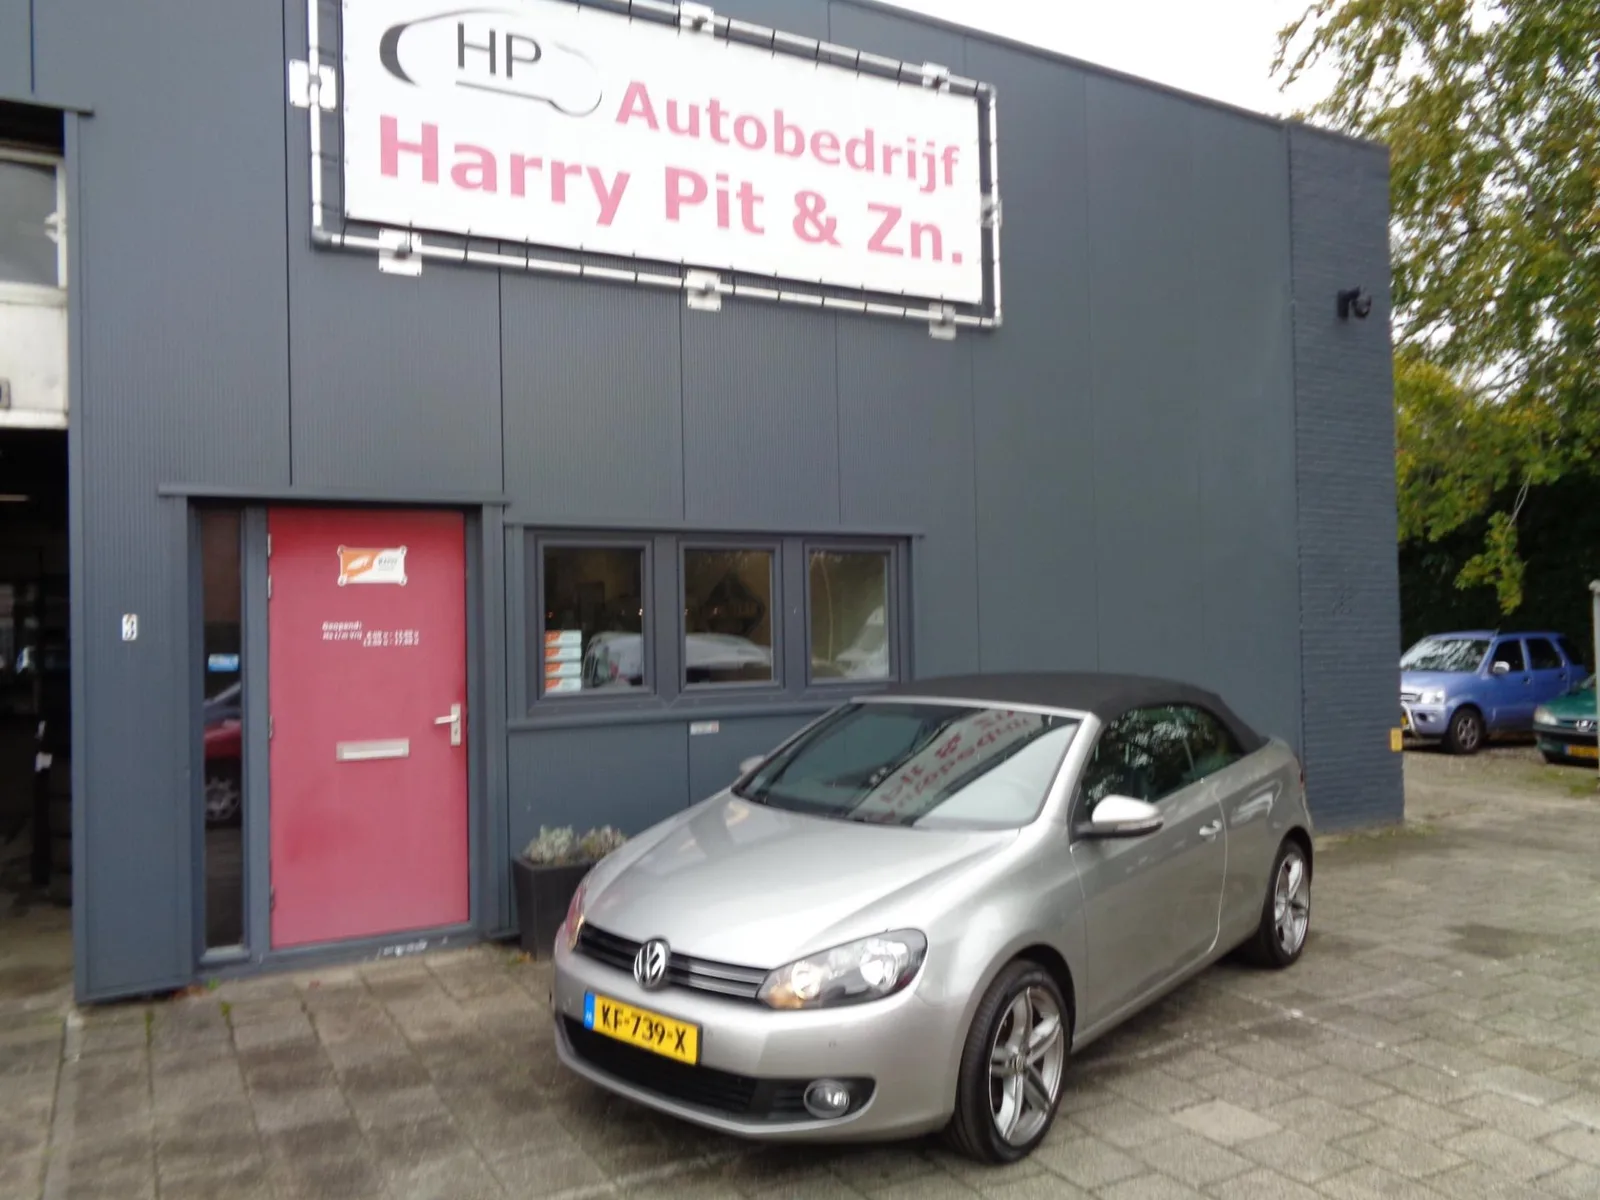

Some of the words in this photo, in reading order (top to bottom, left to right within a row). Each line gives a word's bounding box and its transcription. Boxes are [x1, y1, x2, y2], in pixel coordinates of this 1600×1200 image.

[457, 21, 542, 80] HP
[615, 80, 960, 194] Autobedrijf
[379, 113, 631, 227] Harry
[664, 165, 765, 235] Pit
[792, 189, 841, 248] &
[867, 201, 964, 265] Zn.
[602, 1003, 686, 1055] KF-739-X
